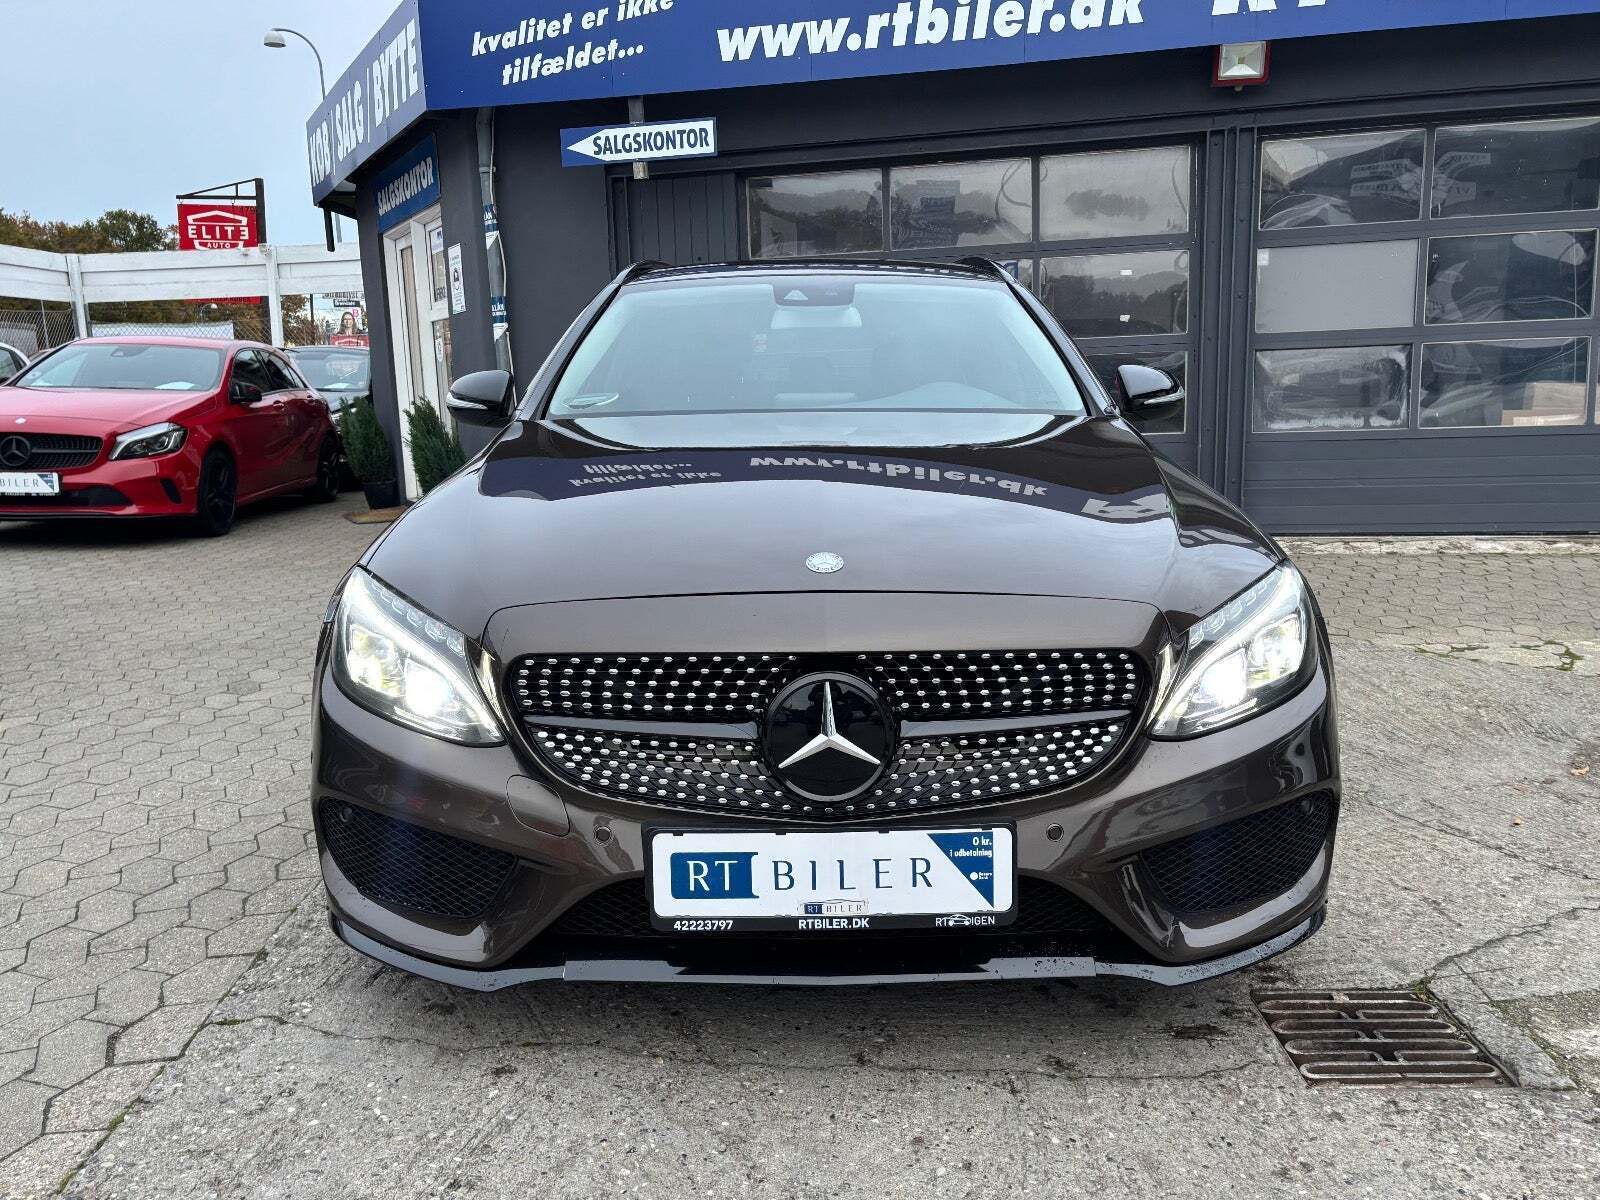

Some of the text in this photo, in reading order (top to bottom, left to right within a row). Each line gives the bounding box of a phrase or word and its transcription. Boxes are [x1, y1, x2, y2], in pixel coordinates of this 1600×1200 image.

[471, 12, 573, 57] kvalitet
[581, 7, 609, 30] er
[335, 80, 364, 162] SALG
[372, 18, 419, 128] BYTTE
[592, 127, 710, 156] SALGSKONTOR
[377, 156, 434, 216] SALGSKONTOR
[187, 225, 249, 240] ELITE
[981, 836, 993, 846] kr.
[954, 848, 993, 858] udbetaling
[686, 857, 933, 892] RT BILER
[807, 904, 862, 913] RT BILER
[673, 920, 734, 931] 42223797
[798, 917, 870, 929] RTBILER.DK
